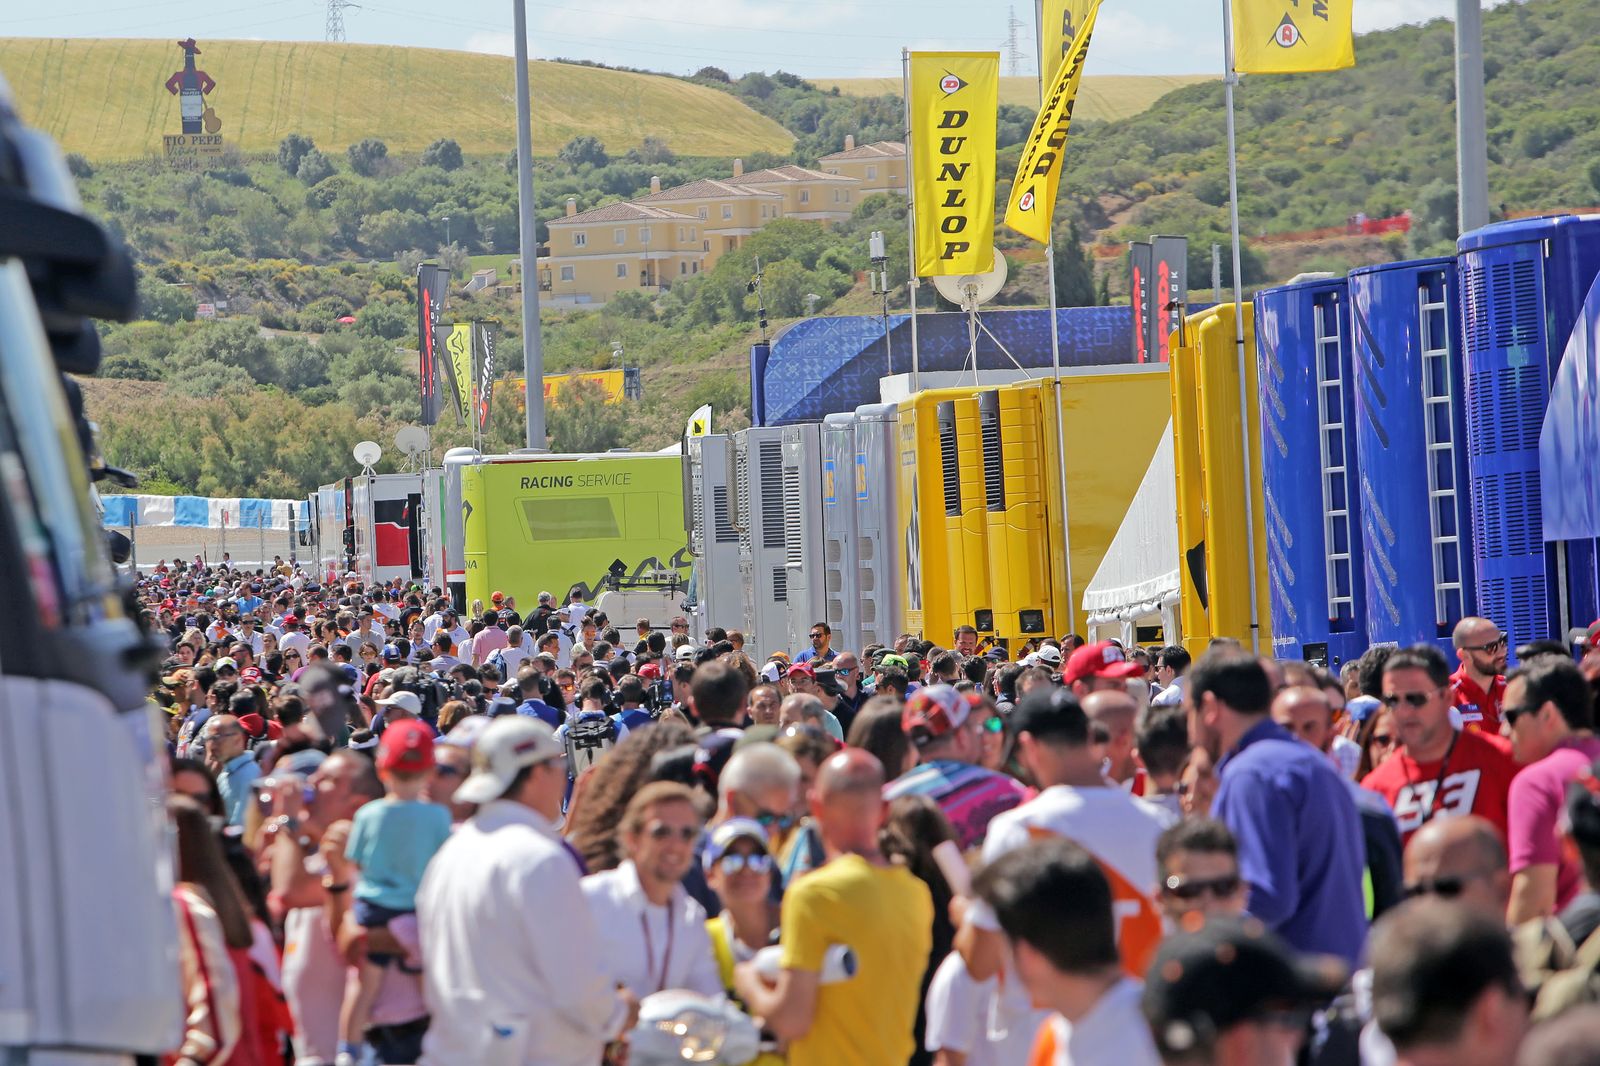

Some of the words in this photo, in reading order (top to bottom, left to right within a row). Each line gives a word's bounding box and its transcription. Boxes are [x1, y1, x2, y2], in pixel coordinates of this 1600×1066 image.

[163, 135, 186, 146] TIO
[191, 135, 222, 146] PEPE
[936, 110, 971, 260] DUNLOP
[520, 475, 574, 489] RACING
[577, 472, 632, 487] SERVICE
[1393, 769, 1481, 833] 93
